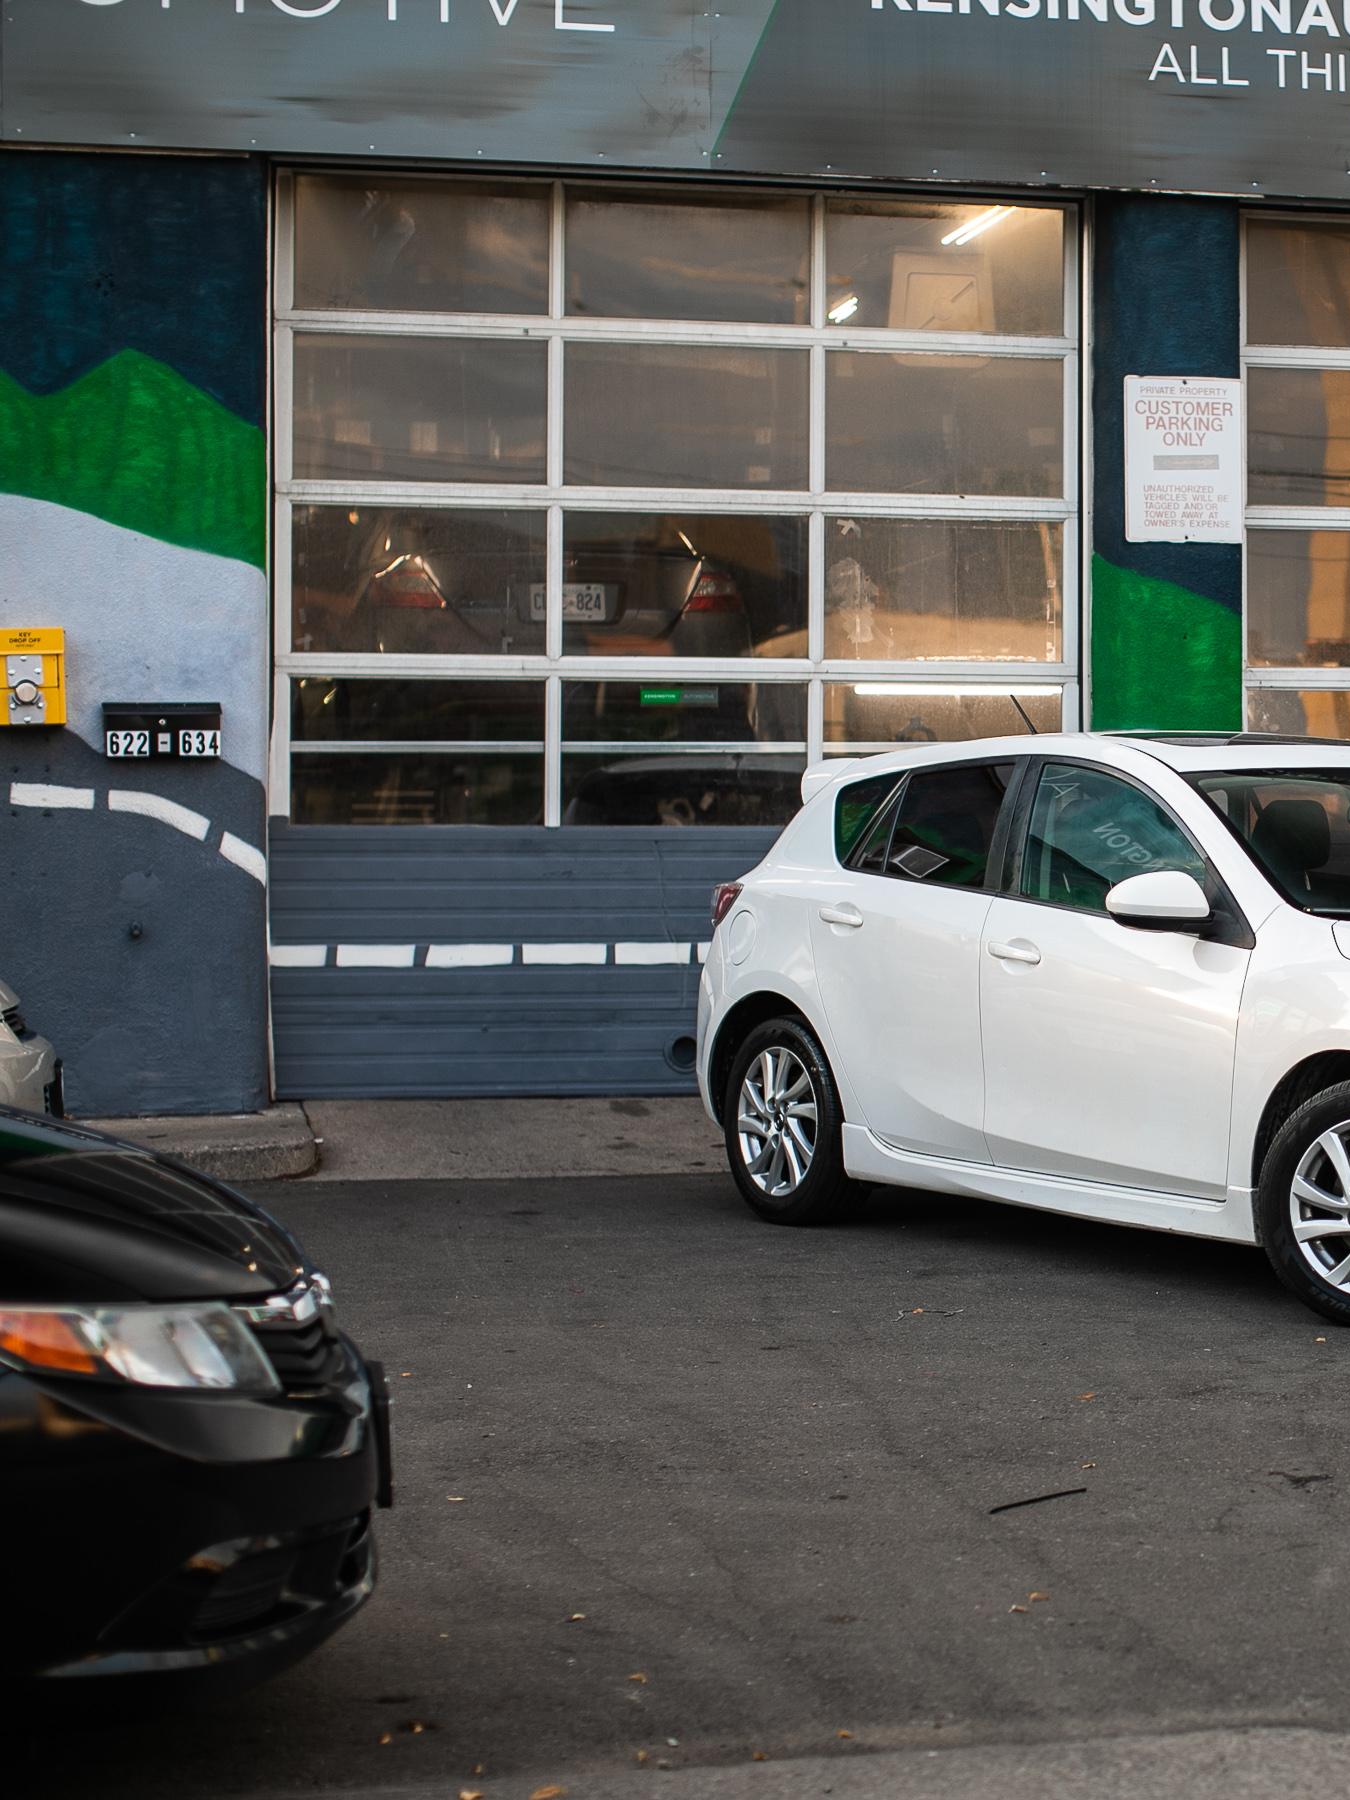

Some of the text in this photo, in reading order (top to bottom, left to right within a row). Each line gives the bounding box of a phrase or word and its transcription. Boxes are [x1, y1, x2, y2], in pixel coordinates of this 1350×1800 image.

[1148, 43, 1250, 86] ALL
[1139, 386, 1228, 396] PRIVATE PROPERTY
[1135, 400, 1233, 416] CUSTOMER
[1145, 416, 1223, 431] PARKING
[1163, 432, 1206, 446] ONLY
[1143, 485, 1214, 494] UNAUTHORIZED
[1144, 493, 1187, 501] VEHICLES
[1192, 494, 1213, 502] WILL
[1144, 502, 1180, 510] TAGGED
[1144, 510, 1177, 518] TOWED
[1181, 511, 1203, 519] AWAY
[1189, 520, 1231, 528] EXPENSE
[109, 732, 148, 755] 622
[182, 731, 218, 754] 634
